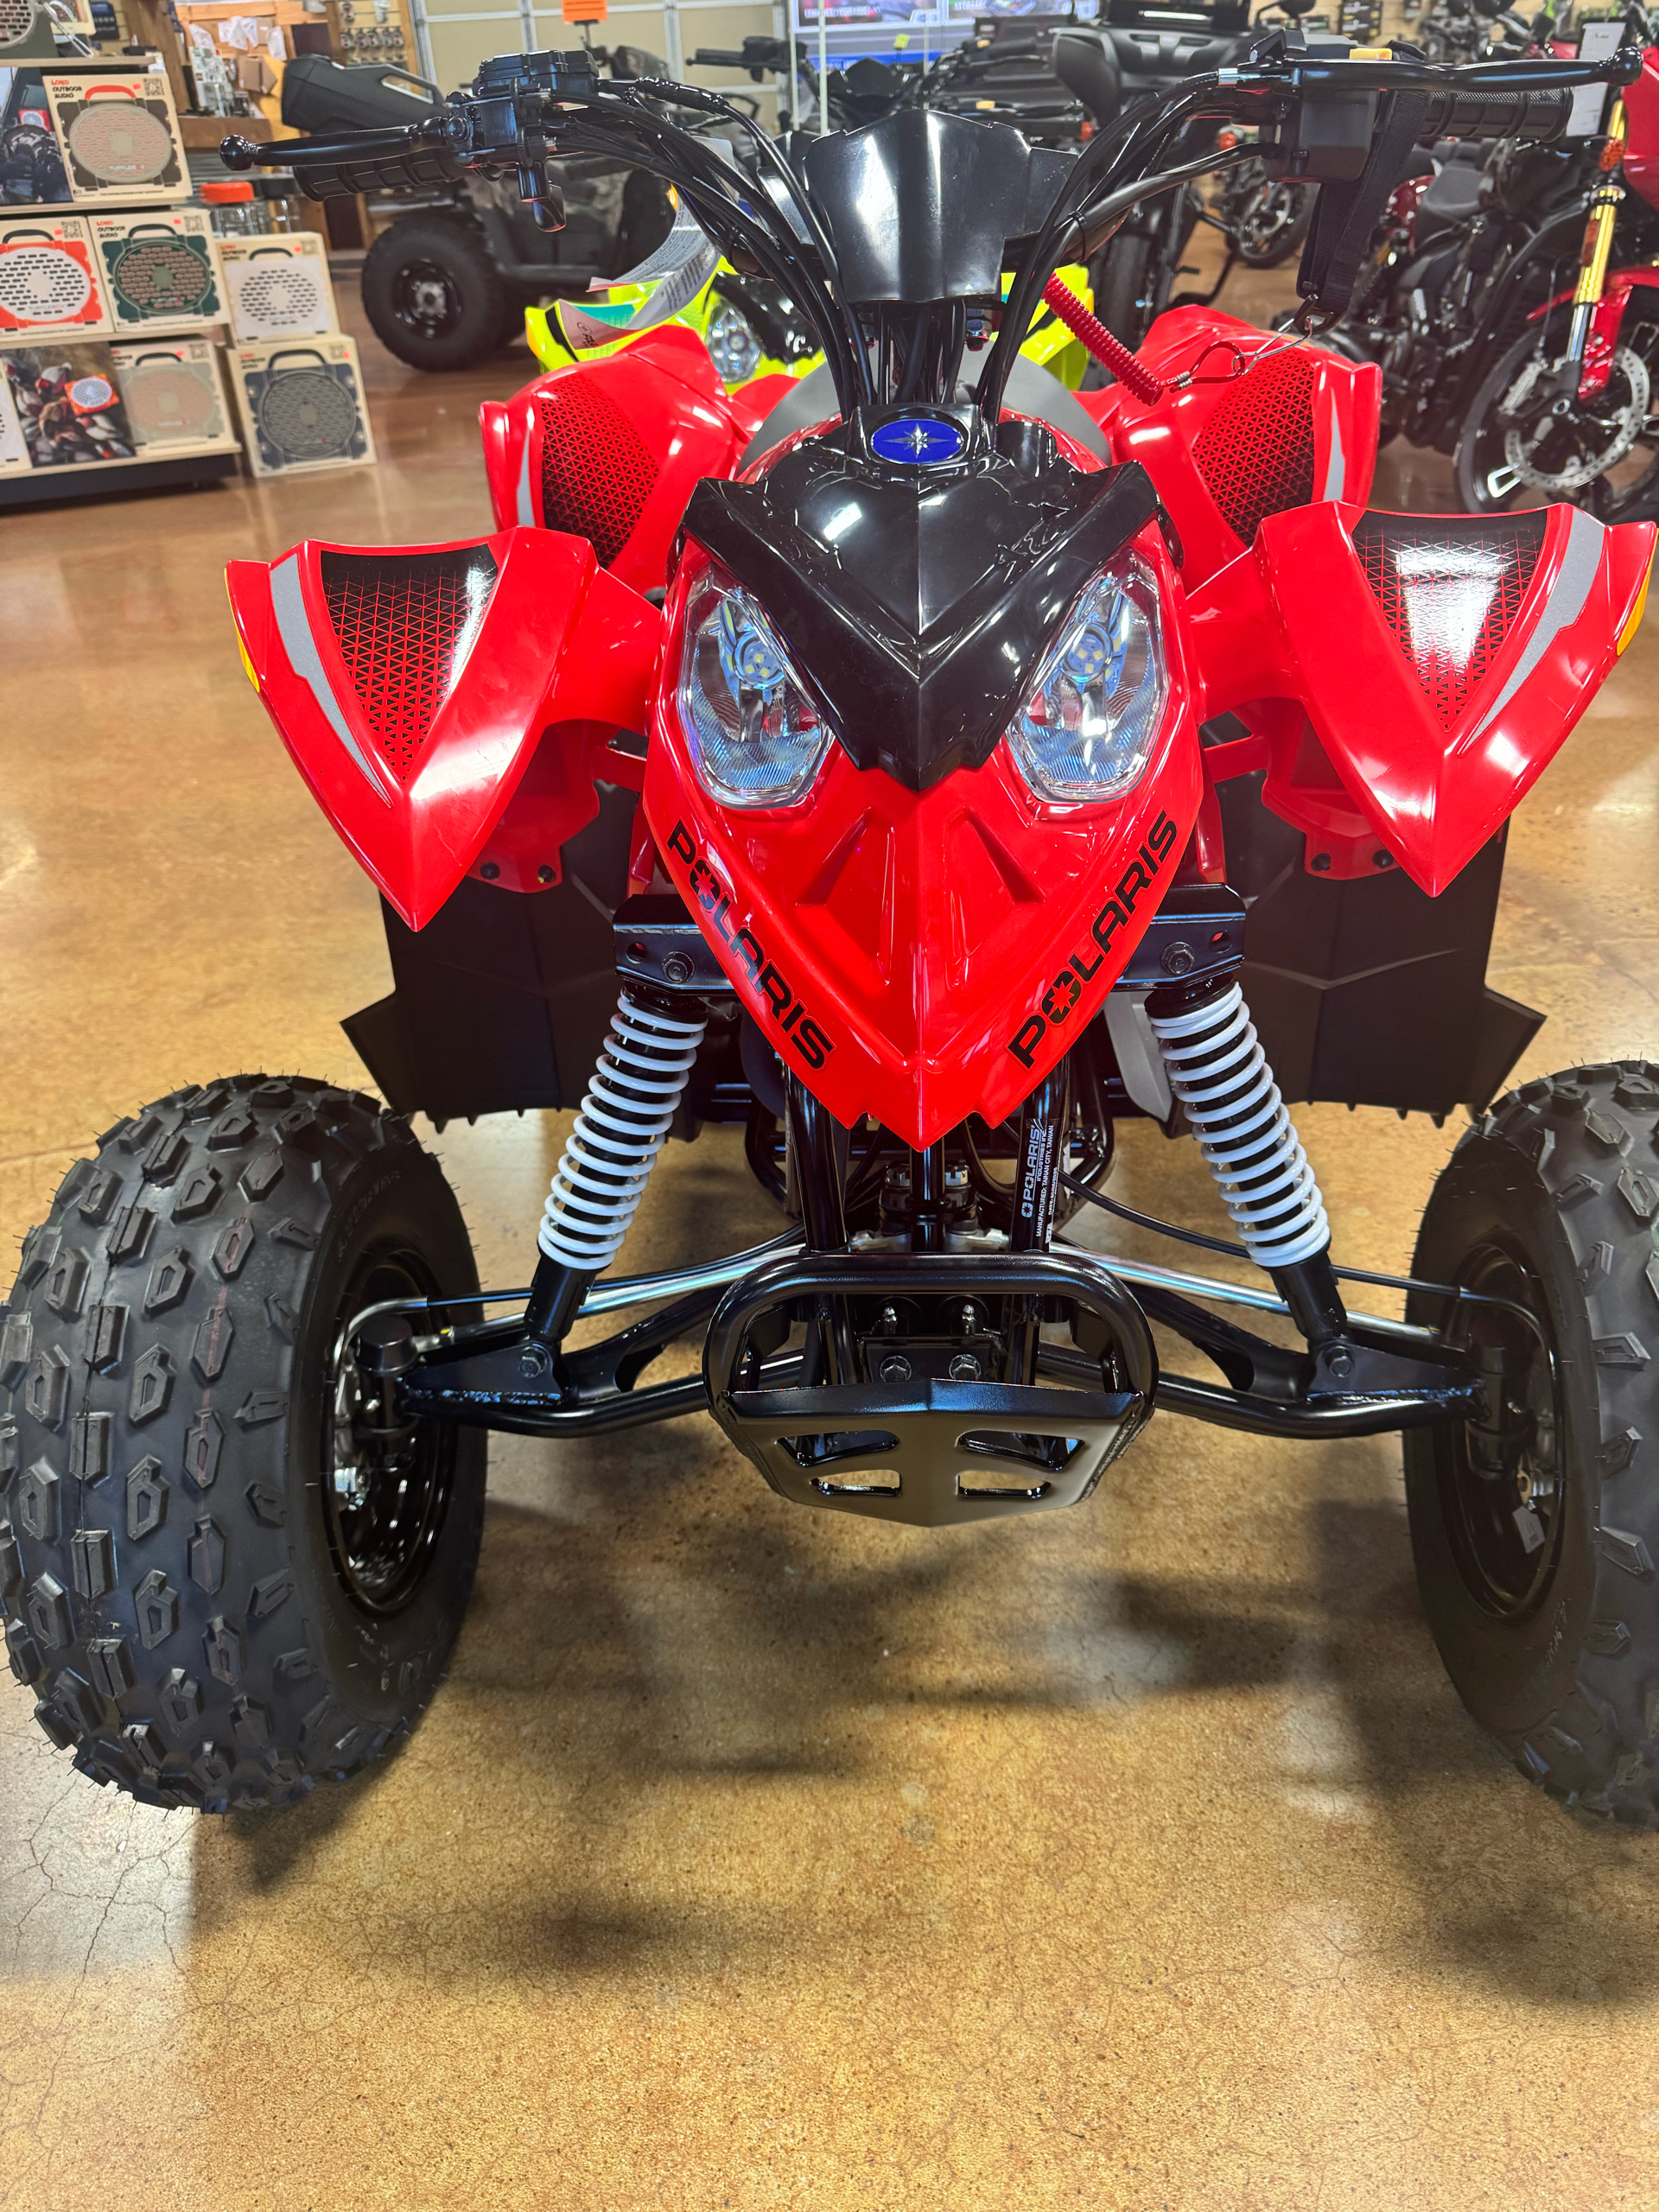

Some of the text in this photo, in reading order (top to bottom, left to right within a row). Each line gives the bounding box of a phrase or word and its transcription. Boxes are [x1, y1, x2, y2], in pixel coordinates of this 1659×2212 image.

[666, 819, 834, 1070] POLARIS
[1007, 810, 1177, 1070] POLARIS
[1023, 1128, 1040, 1201] POLARIS
[1036, 1186, 1047, 1237] MANUFACTURED:
